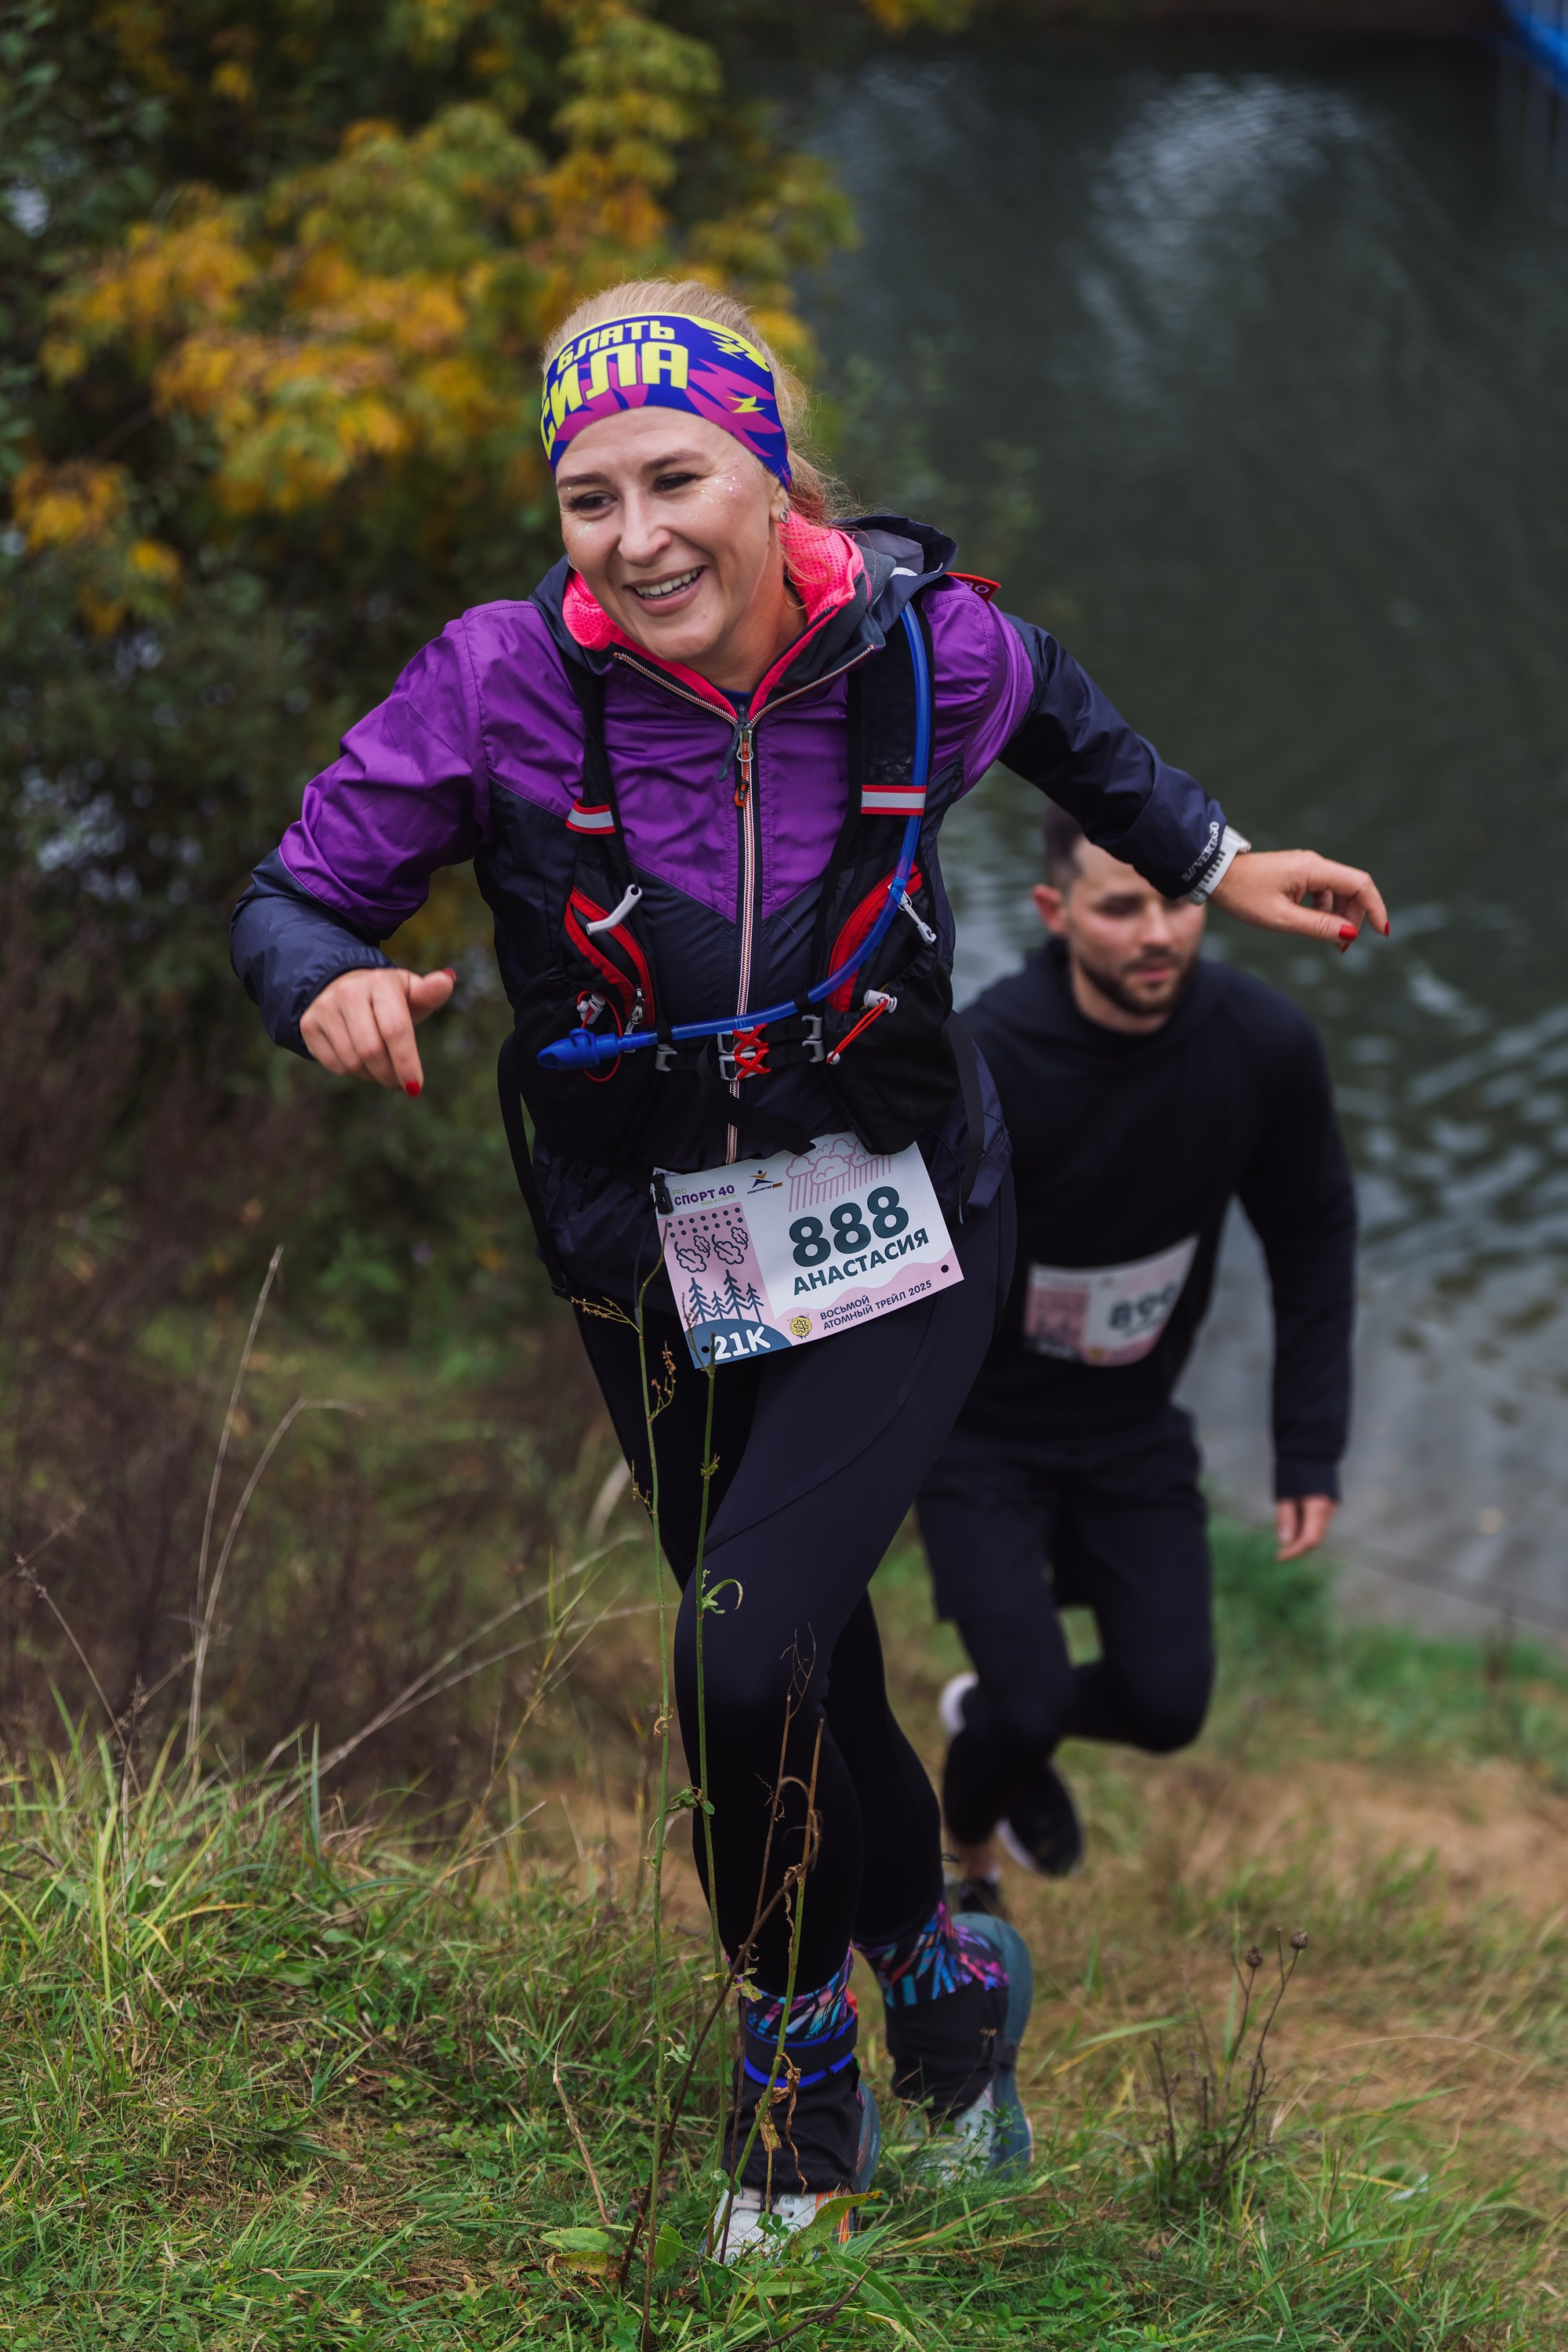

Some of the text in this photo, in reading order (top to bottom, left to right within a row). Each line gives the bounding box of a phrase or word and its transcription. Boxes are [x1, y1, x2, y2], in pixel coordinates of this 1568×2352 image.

[541, 342, 688, 460] СИЛА
[674, 1185, 735, 1206] СПОРТ 40
[789, 1185, 909, 1268] 888
[793, 1228, 929, 1296] АНАСТАСИЯ
[820, 1295, 869, 1320] ВОСЬМОЙ
[823, 1280, 932, 1330] АТОМНЫЙ ТРЕЙЛ 2025
